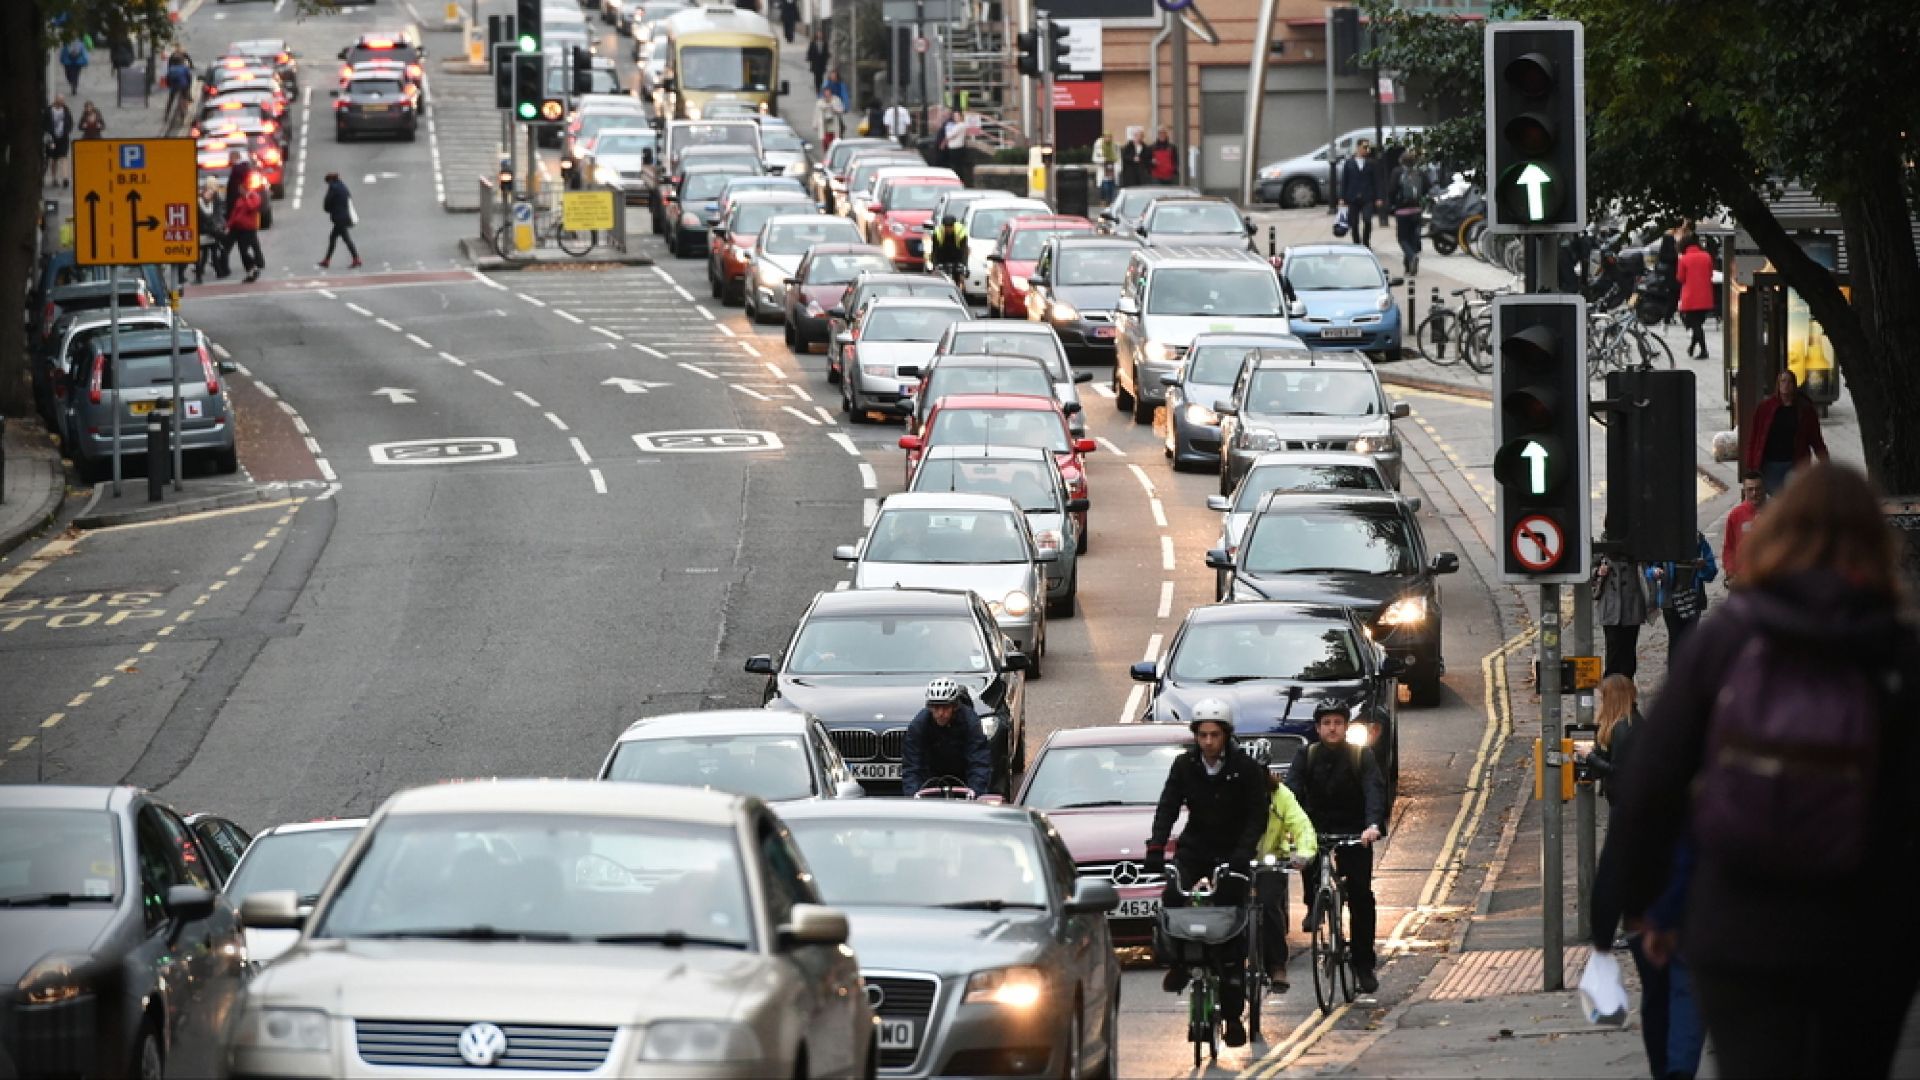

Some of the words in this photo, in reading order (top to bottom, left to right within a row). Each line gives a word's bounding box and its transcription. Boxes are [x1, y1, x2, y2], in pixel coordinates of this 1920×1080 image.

[124, 146, 140, 168] P
[117, 173, 149, 184] B.R.I.
[168, 206, 185, 225] H
[165, 245, 191, 256] only
[190, 405, 199, 414] L
[655, 436, 760, 449] 20
[391, 444, 493, 459] 20
[853, 765, 886, 777] K400
[1121, 901, 1158, 915] 4634
